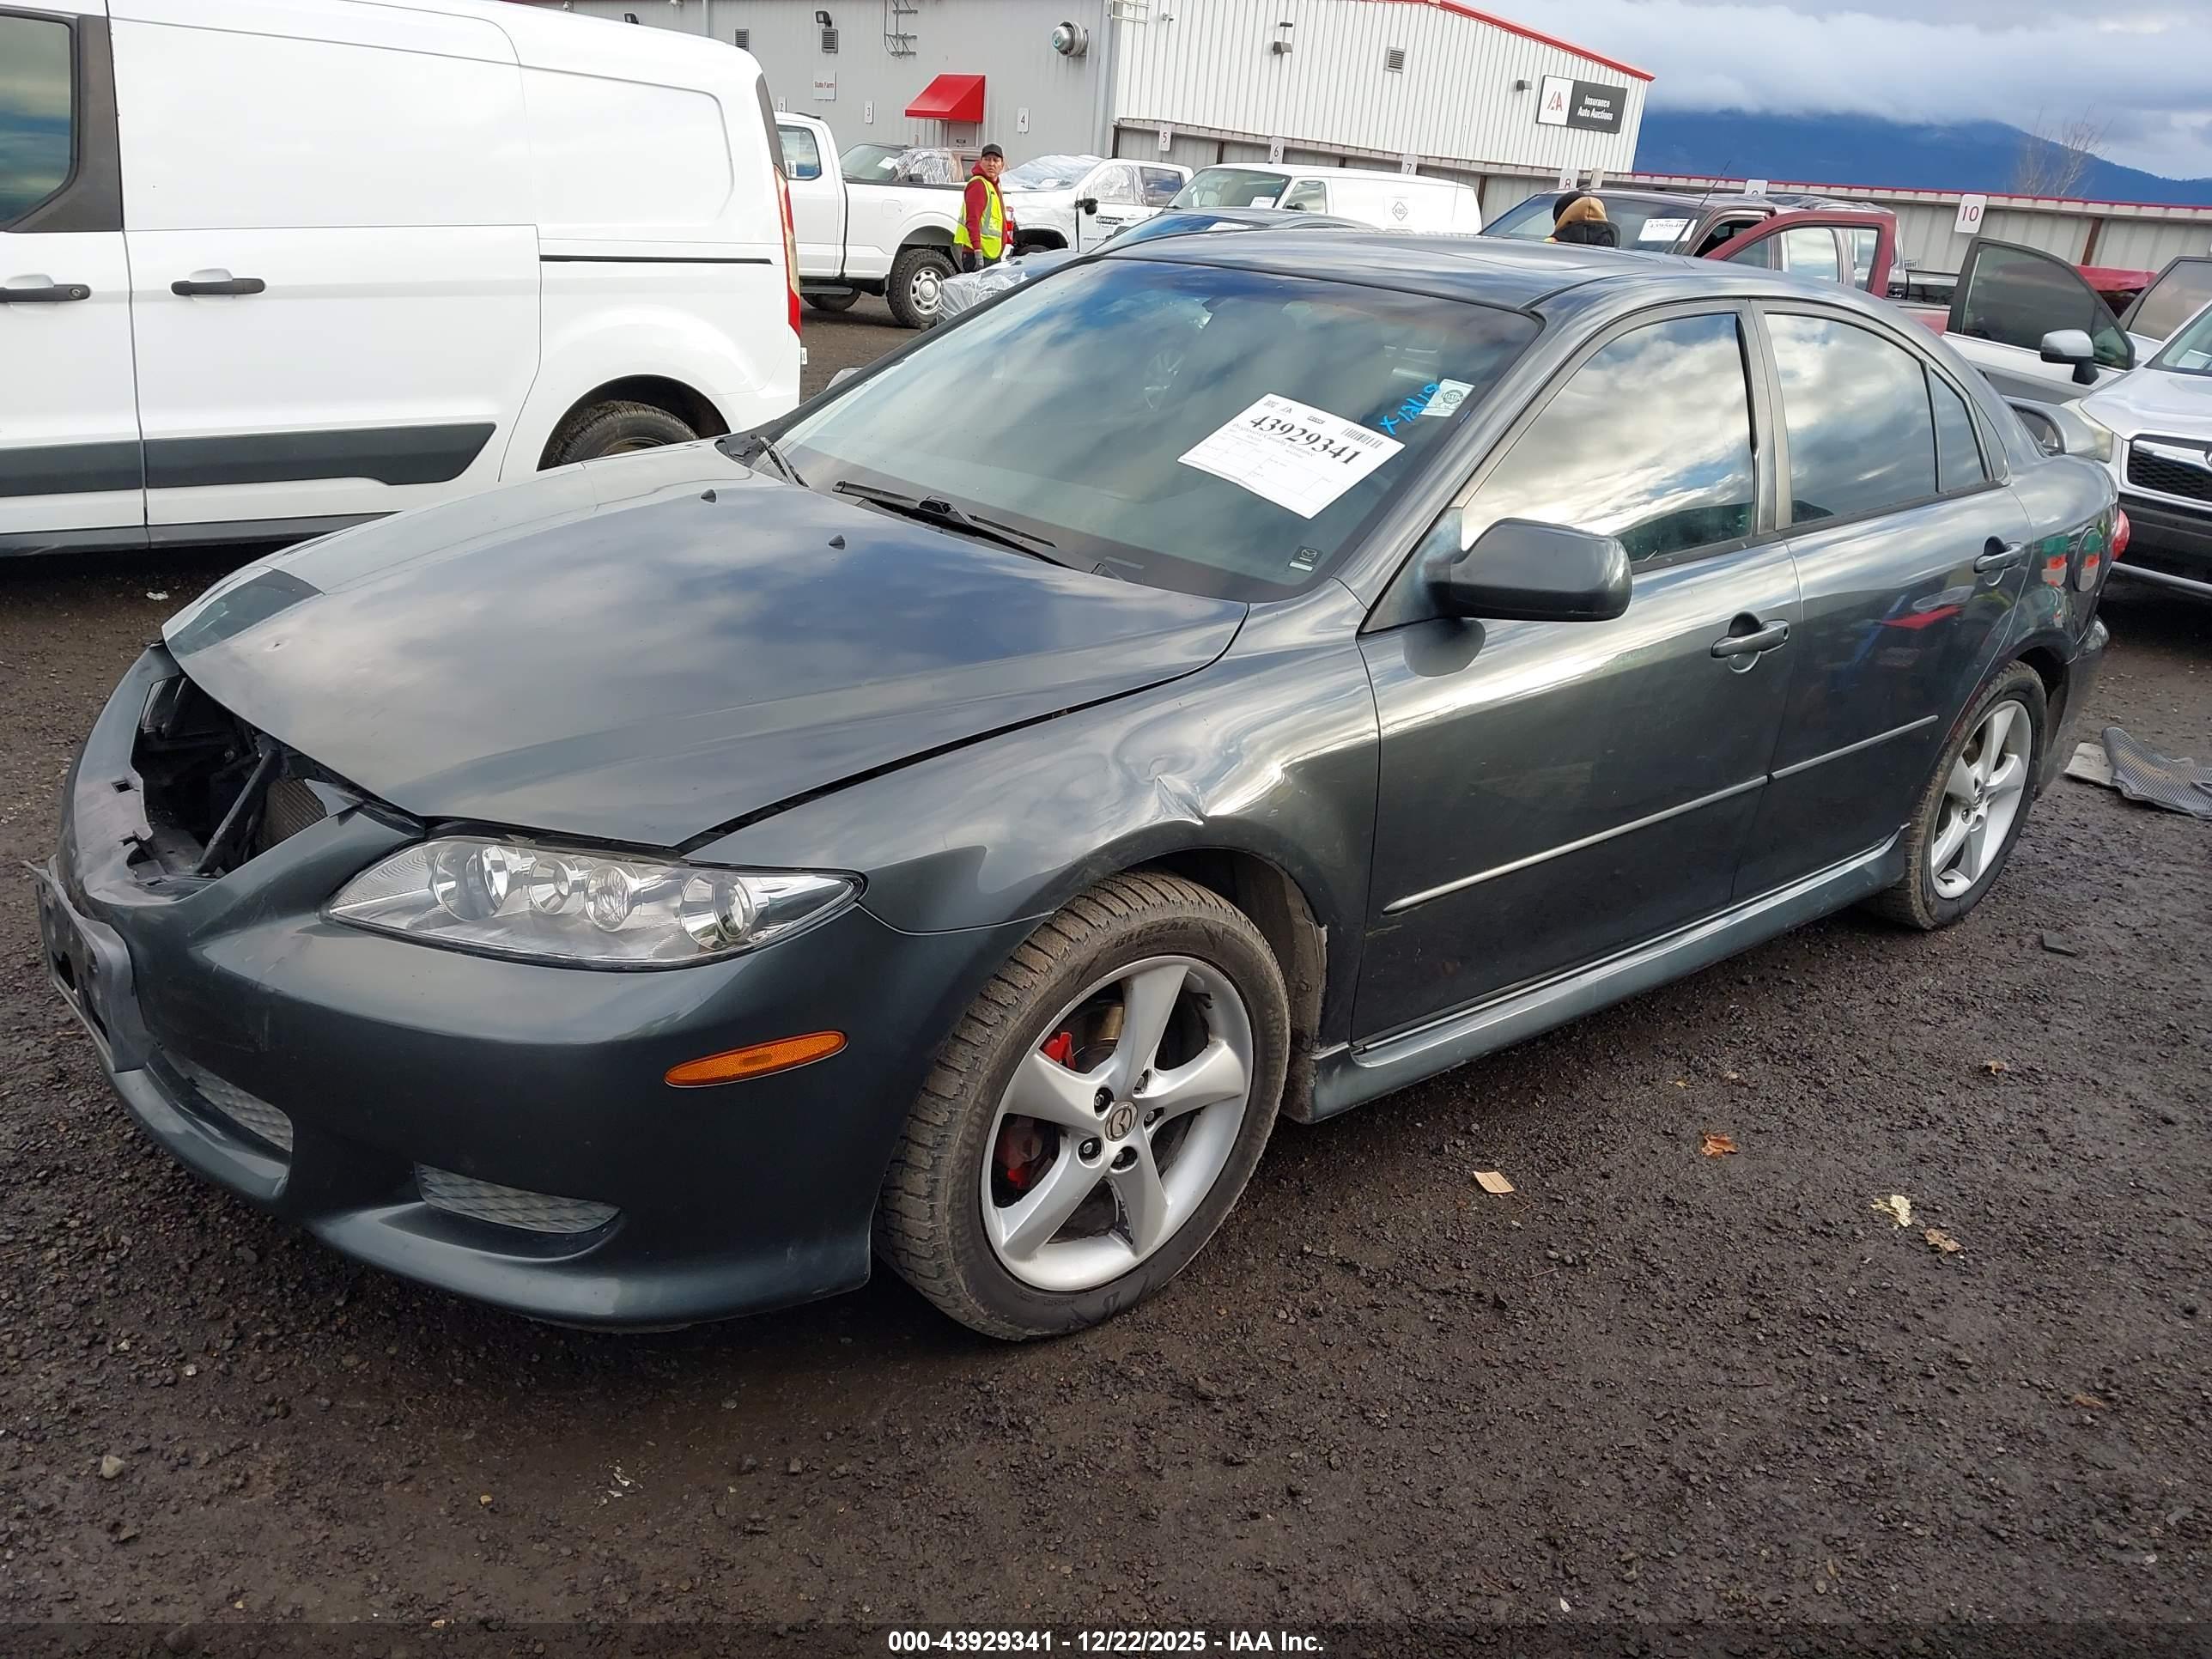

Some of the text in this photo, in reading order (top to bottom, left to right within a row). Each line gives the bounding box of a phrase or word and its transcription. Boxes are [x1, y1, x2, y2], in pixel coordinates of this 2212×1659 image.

[1584, 94, 1611, 108] Insurance
[866, 107, 871, 117] 3
[1020, 113, 1025, 125] 4
[1577, 106, 1613, 121] Auto Auctions
[1162, 131, 1168, 143] 5
[1273, 144, 1279, 158] 6
[1407, 162, 1413, 175] 7
[1961, 205, 1979, 222] 10
[1249, 415, 1362, 465] 43929341
